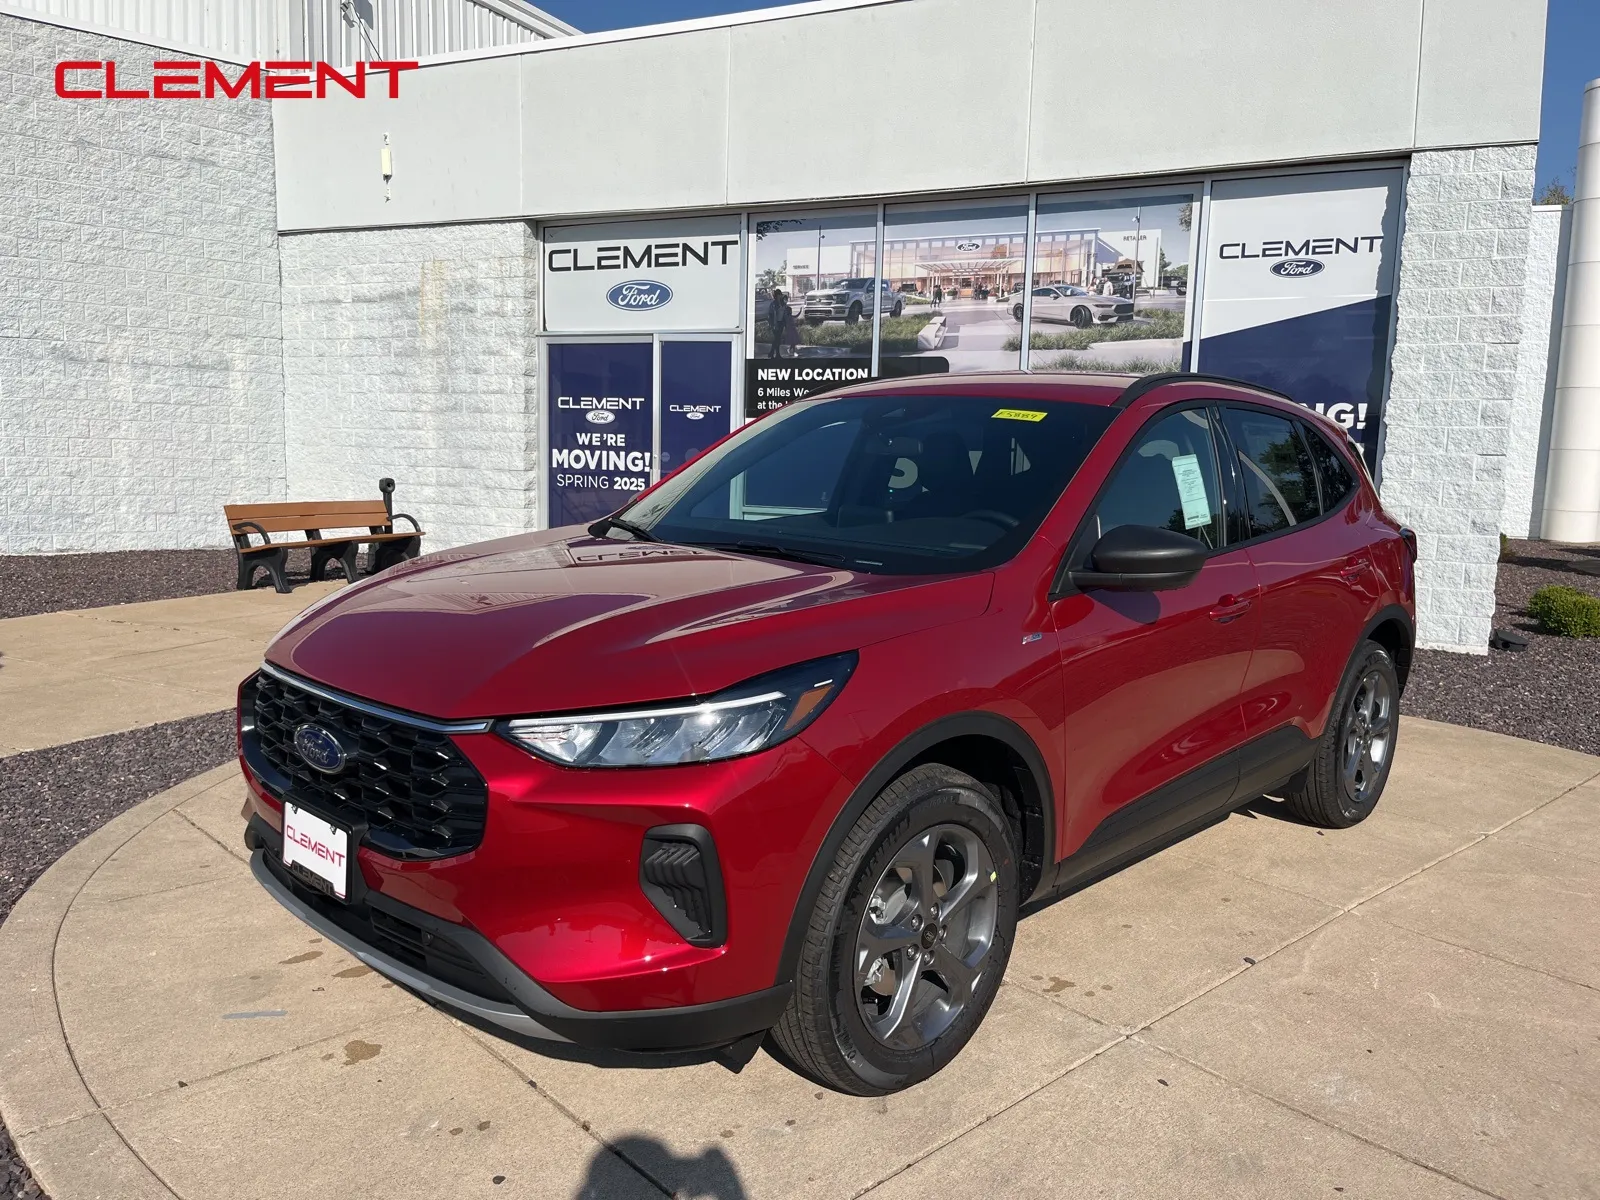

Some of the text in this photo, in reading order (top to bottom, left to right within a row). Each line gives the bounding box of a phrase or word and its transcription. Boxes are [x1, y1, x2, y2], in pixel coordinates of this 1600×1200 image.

[1219, 235, 1385, 260] CLEMENT
[548, 240, 739, 272] CLEMENT
[1279, 261, 1314, 276] Ford
[616, 283, 662, 308] Ford
[757, 368, 868, 381] NEW LOCATION
[757, 387, 764, 397] 6
[766, 387, 791, 397] Miles
[557, 396, 645, 411] CLEMENT
[669, 404, 722, 414] CLEMENT
[757, 400, 767, 410] at
[768, 400, 783, 410] the
[589, 410, 612, 423] Ford
[552, 448, 651, 473] MOVING!
[556, 473, 646, 491] SPRING 2025
[301, 733, 331, 764] Ford
[286, 824, 345, 867] CLEMENT
